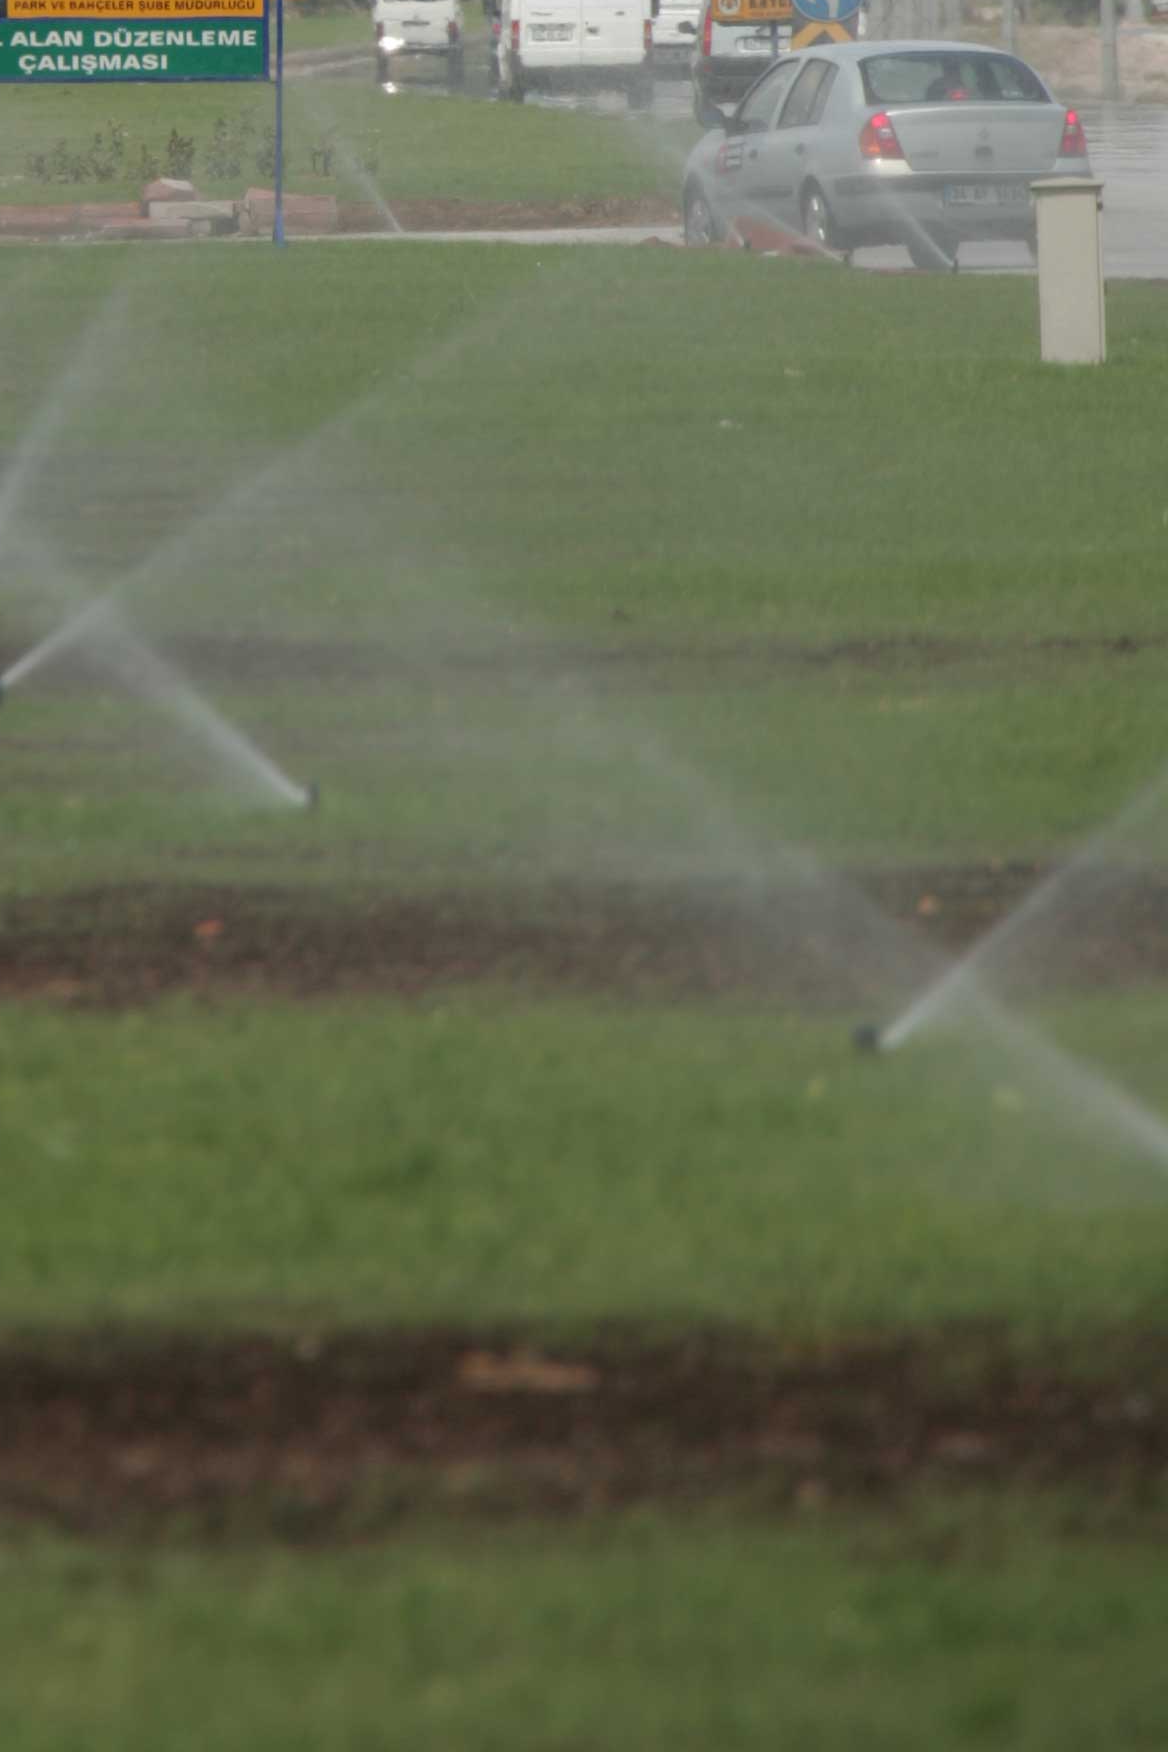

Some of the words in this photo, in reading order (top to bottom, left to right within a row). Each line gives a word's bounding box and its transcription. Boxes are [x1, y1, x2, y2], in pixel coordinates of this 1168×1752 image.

[14, 0, 47, 10] PARK
[51, 0, 65, 10] VE
[69, 0, 134, 13] BAHÇELER
[138, 0, 171, 14] ŞUBE
[10, 31, 83, 47] ALAN
[94, 27, 257, 47] DÜZENLEME
[18, 53, 169, 75] ÇALIŞMASI
